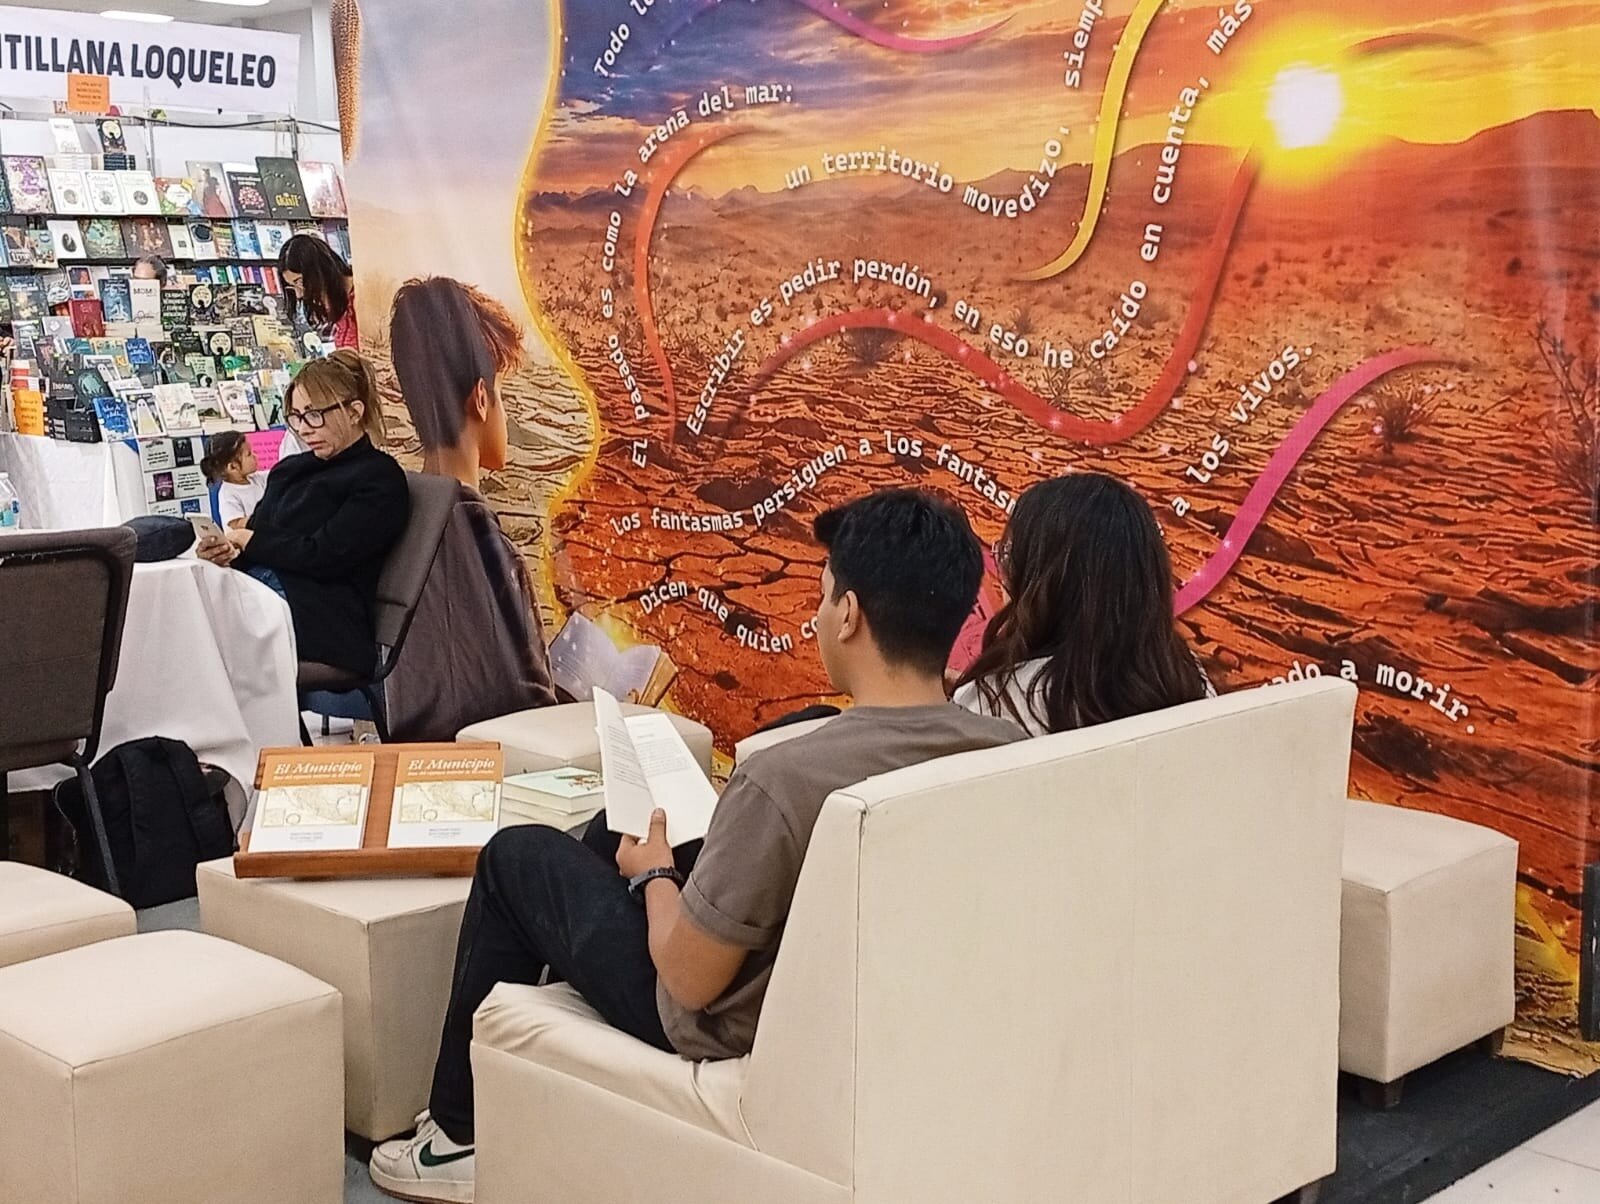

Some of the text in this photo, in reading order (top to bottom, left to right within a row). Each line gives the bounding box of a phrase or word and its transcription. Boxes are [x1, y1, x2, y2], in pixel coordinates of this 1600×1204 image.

[0, 33, 276, 88] TILLANA LOQUELEO
[593, 23, 630, 77] Todo
[1063, 0, 1104, 89] siemp
[785, 126, 1070, 217] un territorio movedizo,
[686, 0, 1252, 436] Escribir es pedir perdón, en eso he caído en cuenta, más
[601, 82, 793, 469] El pasado es como la arena del mar:
[1172, 345, 1312, 517] a los vivos.
[610, 512, 641, 537] los
[650, 507, 744, 532] fantasmas
[752, 443, 848, 526] persiguen
[858, 438, 873, 457] a
[884, 430, 923, 458] los
[639, 581, 688, 615] Dicen
[697, 586, 729, 623] que
[736, 624, 792, 653] quien
[1339, 659, 1359, 681] a
[1376, 663, 1475, 735] morir.
[274, 761, 363, 775] El Municipio
[408, 758, 495, 772] El Municipio
